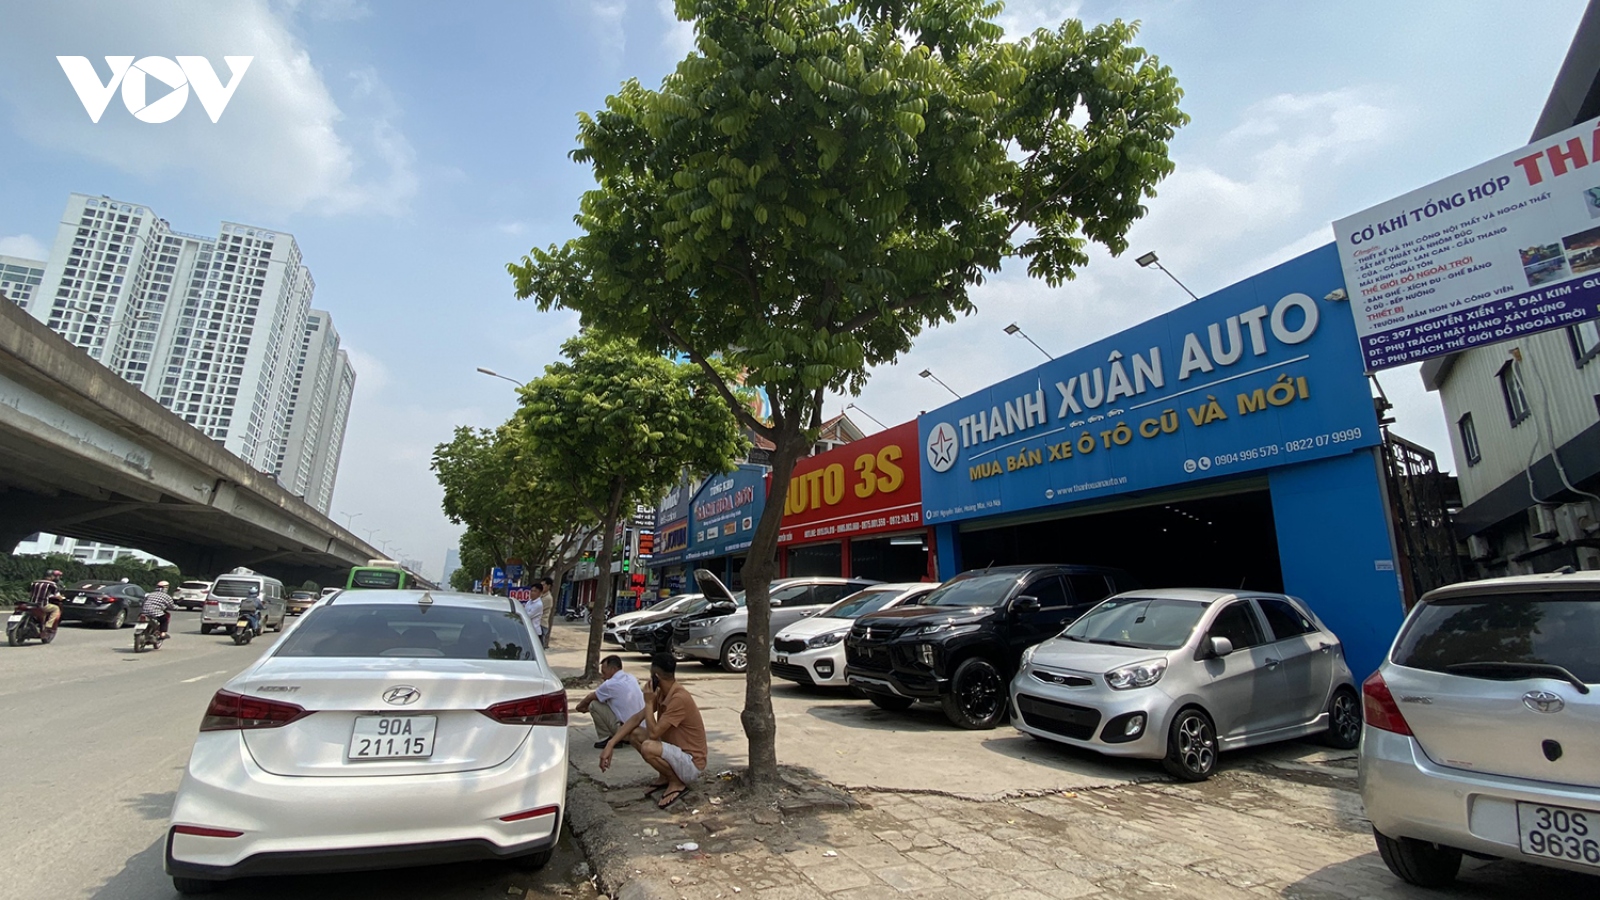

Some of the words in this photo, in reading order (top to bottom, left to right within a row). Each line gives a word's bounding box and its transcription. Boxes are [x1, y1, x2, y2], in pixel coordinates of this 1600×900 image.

[1377, 210, 1408, 236] KHÍ
[1513, 120, 1600, 186] TH
[1402, 240, 1414, 248] THI
[1416, 231, 1440, 244] CÔNG
[1443, 225, 1458, 234] NỘI
[1460, 216, 1480, 228] THẤT
[1482, 212, 1495, 220] VÀ
[1497, 201, 1528, 216] NGOẠI
[1528, 192, 1552, 204] THẤT
[1414, 253, 1430, 262] LAN
[1432, 246, 1450, 256] CAN
[1477, 226, 1508, 240] THANG
[1426, 236, 1452, 248] NHÔM
[1360, 279, 1374, 288] MÁI
[1376, 272, 1394, 282] KÍNH
[1400, 265, 1415, 274] MÁI
[1417, 260, 1433, 268] TÔN
[1361, 284, 1378, 296] THẾ
[1416, 264, 1447, 279] NGOÀI
[1366, 309, 1392, 321] THIẾT
[1392, 329, 1412, 340] 397
[1414, 314, 1463, 334] NGUYỄN
[1504, 302, 1516, 310] P.
[1518, 294, 1543, 306] ĐẠI
[1546, 285, 1572, 299] KIM
[1429, 305, 1448, 314] NON
[1450, 299, 1462, 307] VÀ
[1464, 292, 1492, 303] CÔNG
[1494, 284, 1514, 295] VIÊN
[1385, 342, 1405, 352] PHỤ
[1407, 332, 1441, 348] TRÁCH
[1444, 326, 1466, 338] MẶT
[1468, 317, 1502, 332] HÀNG
[1504, 310, 1528, 322] XÂY
[1531, 300, 1566, 316] DỰNG
[1388, 352, 1407, 363] PHỤ
[1409, 343, 1444, 358] TRÁCH
[1446, 336, 1466, 348] THẾ
[1468, 330, 1492, 344] GIỚI
[1495, 325, 1513, 337] ĐỒ
[1516, 316, 1556, 332] NGOÀI
[1558, 308, 1586, 322] TRỜI
[959, 388, 1047, 448] THANH
[1055, 346, 1165, 419] XUÂN
[1178, 292, 1319, 380] AUTO
[969, 460, 1003, 482] MUA
[1007, 447, 1043, 472] BÁN
[1048, 441, 1072, 462] XE
[1077, 431, 1096, 454] Ô
[1100, 421, 1132, 449] TÔ
[1139, 408, 1179, 438] CŨ
[1187, 394, 1228, 426] VÀ
[1236, 373, 1310, 416] MỚI
[1214, 452, 1238, 466] 0904
[1240, 448, 1259, 462] 996
[1259, 444, 1279, 458] 579
[1285, 438, 1314, 453] 0822
[1315, 434, 1330, 446] 07
[1332, 427, 1362, 444] 9999
[854, 444, 904, 498] 3S
[378, 718, 412, 736] 90A
[358, 738, 426, 756] 211.15
[1536, 807, 1588, 836] 30S
[1529, 830, 1600, 864] 9636
